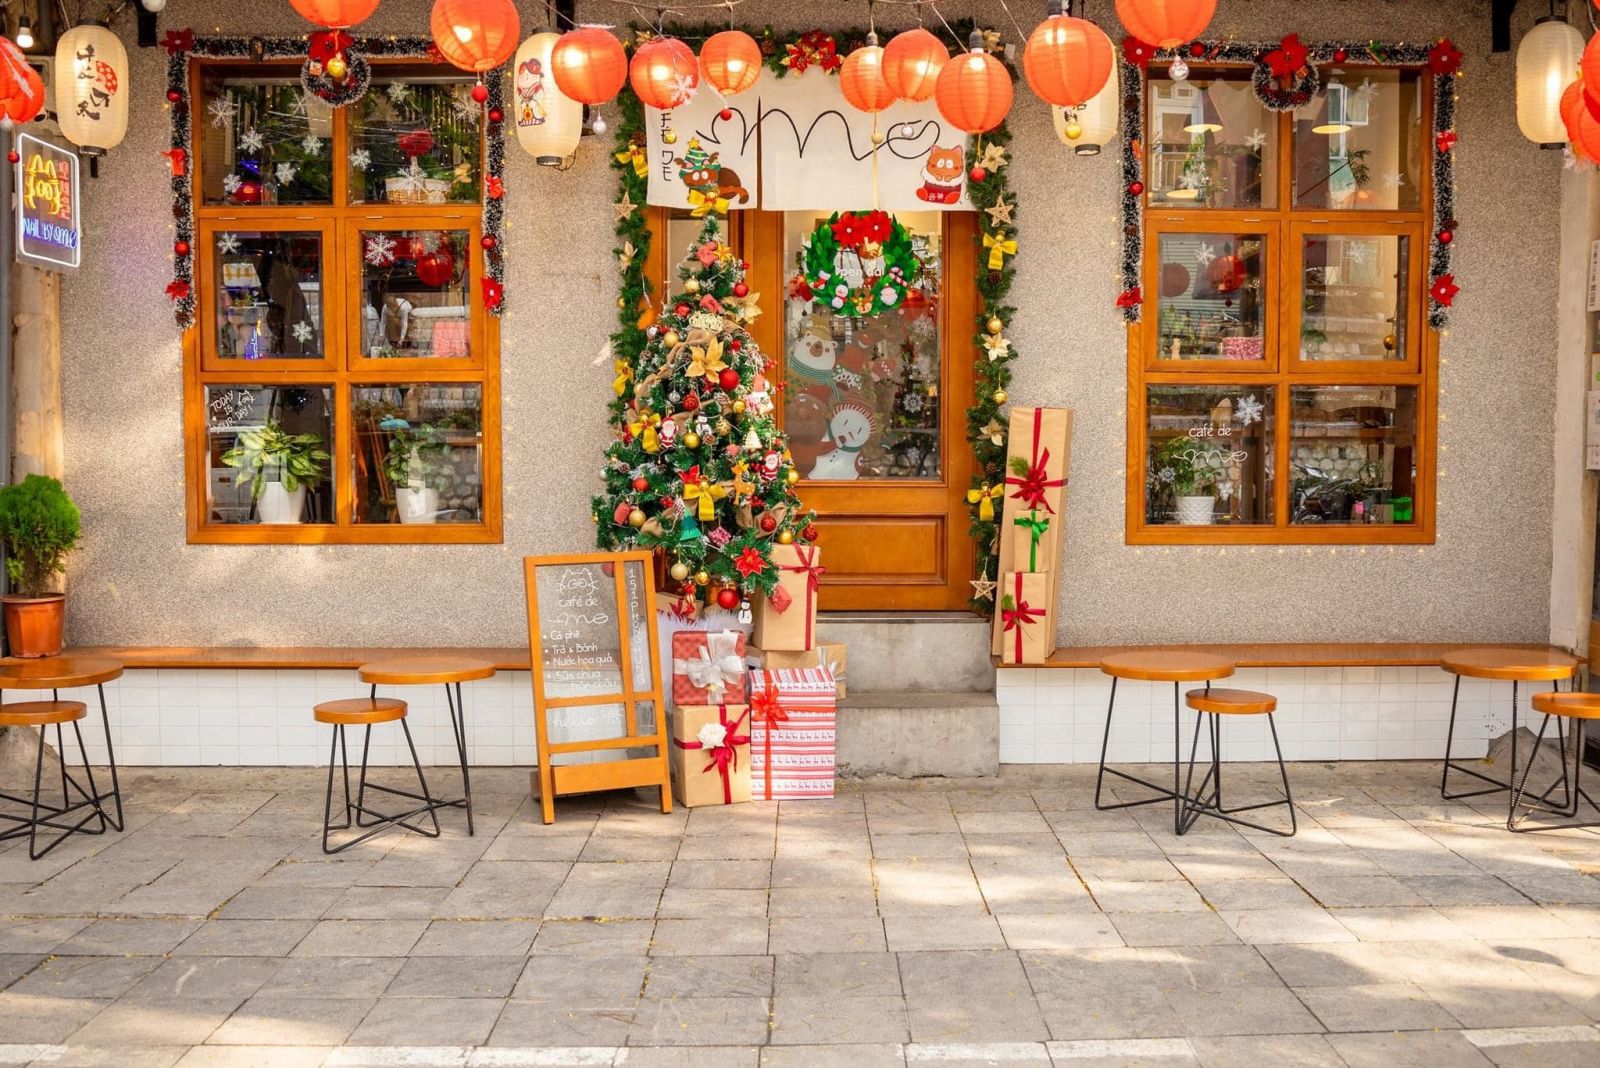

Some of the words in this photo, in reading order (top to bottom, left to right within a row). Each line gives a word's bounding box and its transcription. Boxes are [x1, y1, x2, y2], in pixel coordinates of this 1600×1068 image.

[22, 217, 42, 239] NAIL
[43, 221, 54, 243] BY
[210, 389, 234, 412] TODAY
[224, 404, 233, 416] IS
[234, 403, 254, 420] DAY!
[1188, 422, 1214, 438] café
[1217, 423, 1232, 437] de
[559, 595, 583, 608] café
[585, 595, 598, 607] de
